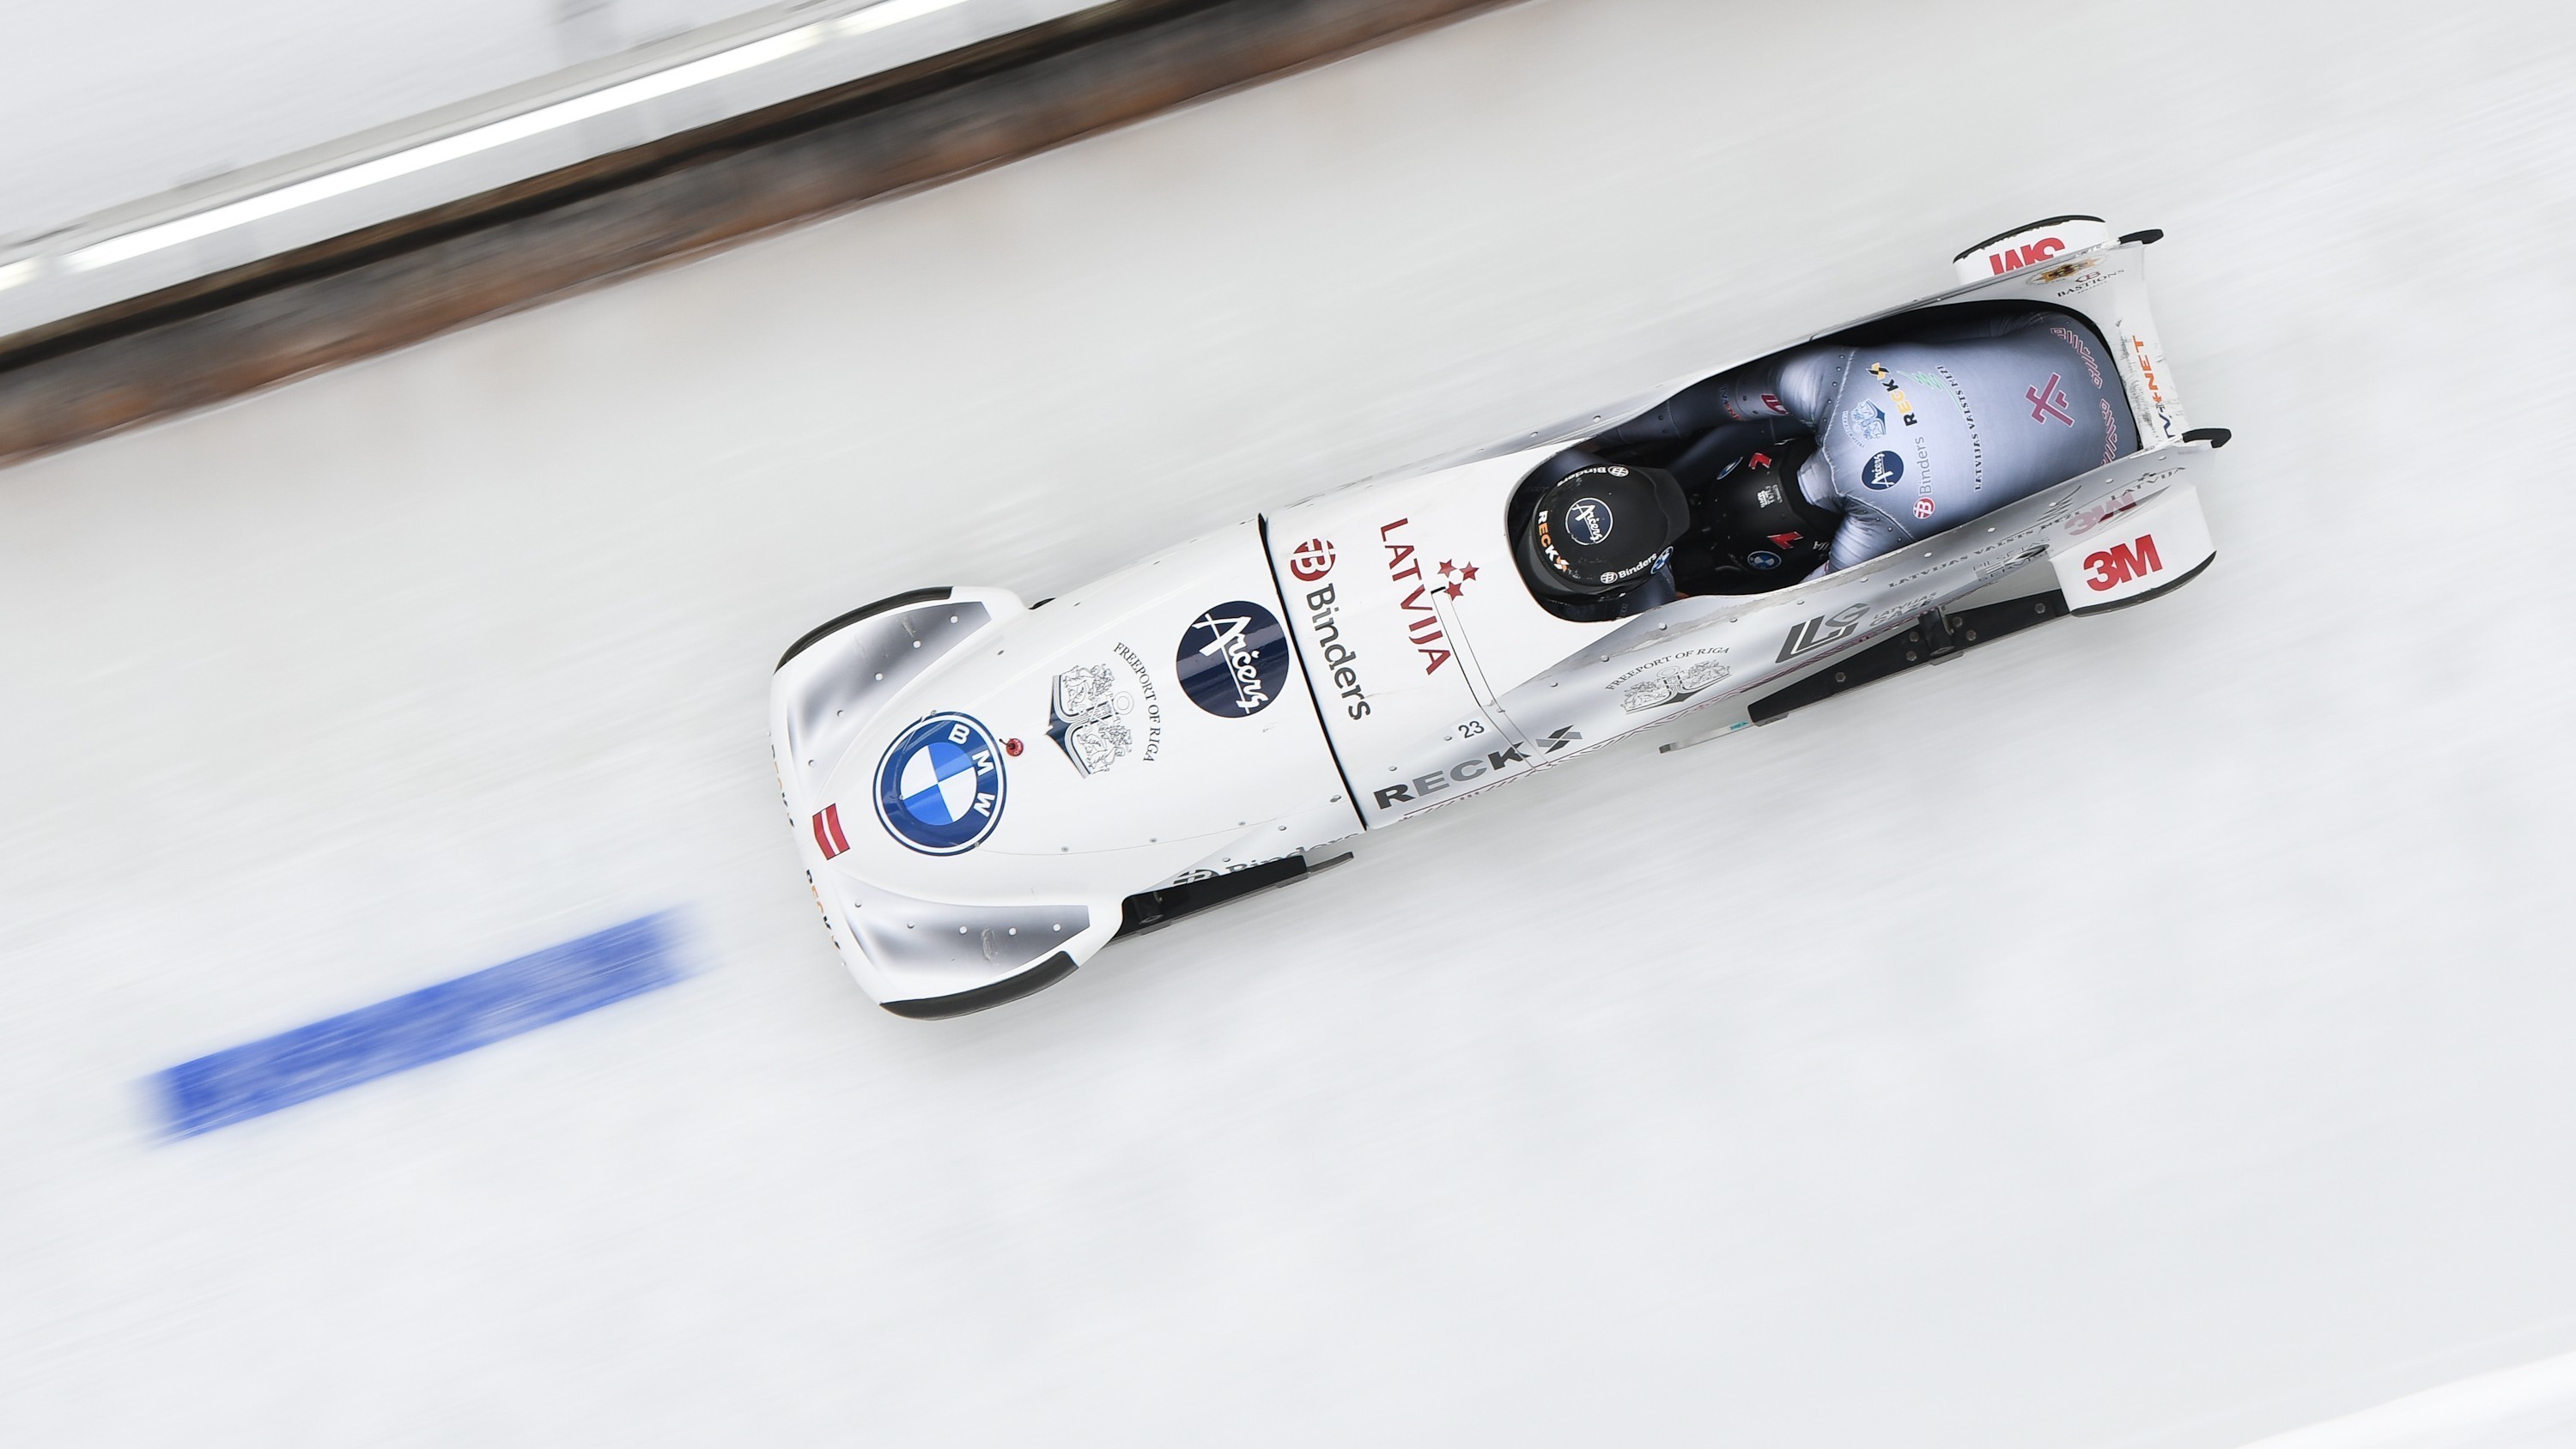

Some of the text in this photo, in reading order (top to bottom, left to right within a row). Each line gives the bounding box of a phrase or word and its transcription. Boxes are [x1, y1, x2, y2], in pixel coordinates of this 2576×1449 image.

[1955, 390, 1976, 430] VALSTS
[1915, 436, 1932, 495] Binders
[1618, 553, 1657, 579] Binders
[2083, 534, 2163, 591] 3M
[1381, 518, 1451, 676] LATVIJA
[1306, 583, 1371, 720] Binders
[1605, 646, 1730, 691] FREEPORT OF RIGA
[1113, 642, 1161, 762] FREEPORT OF RIGA
[1457, 720, 1485, 738] 23
[947, 723, 996, 818] BMW
